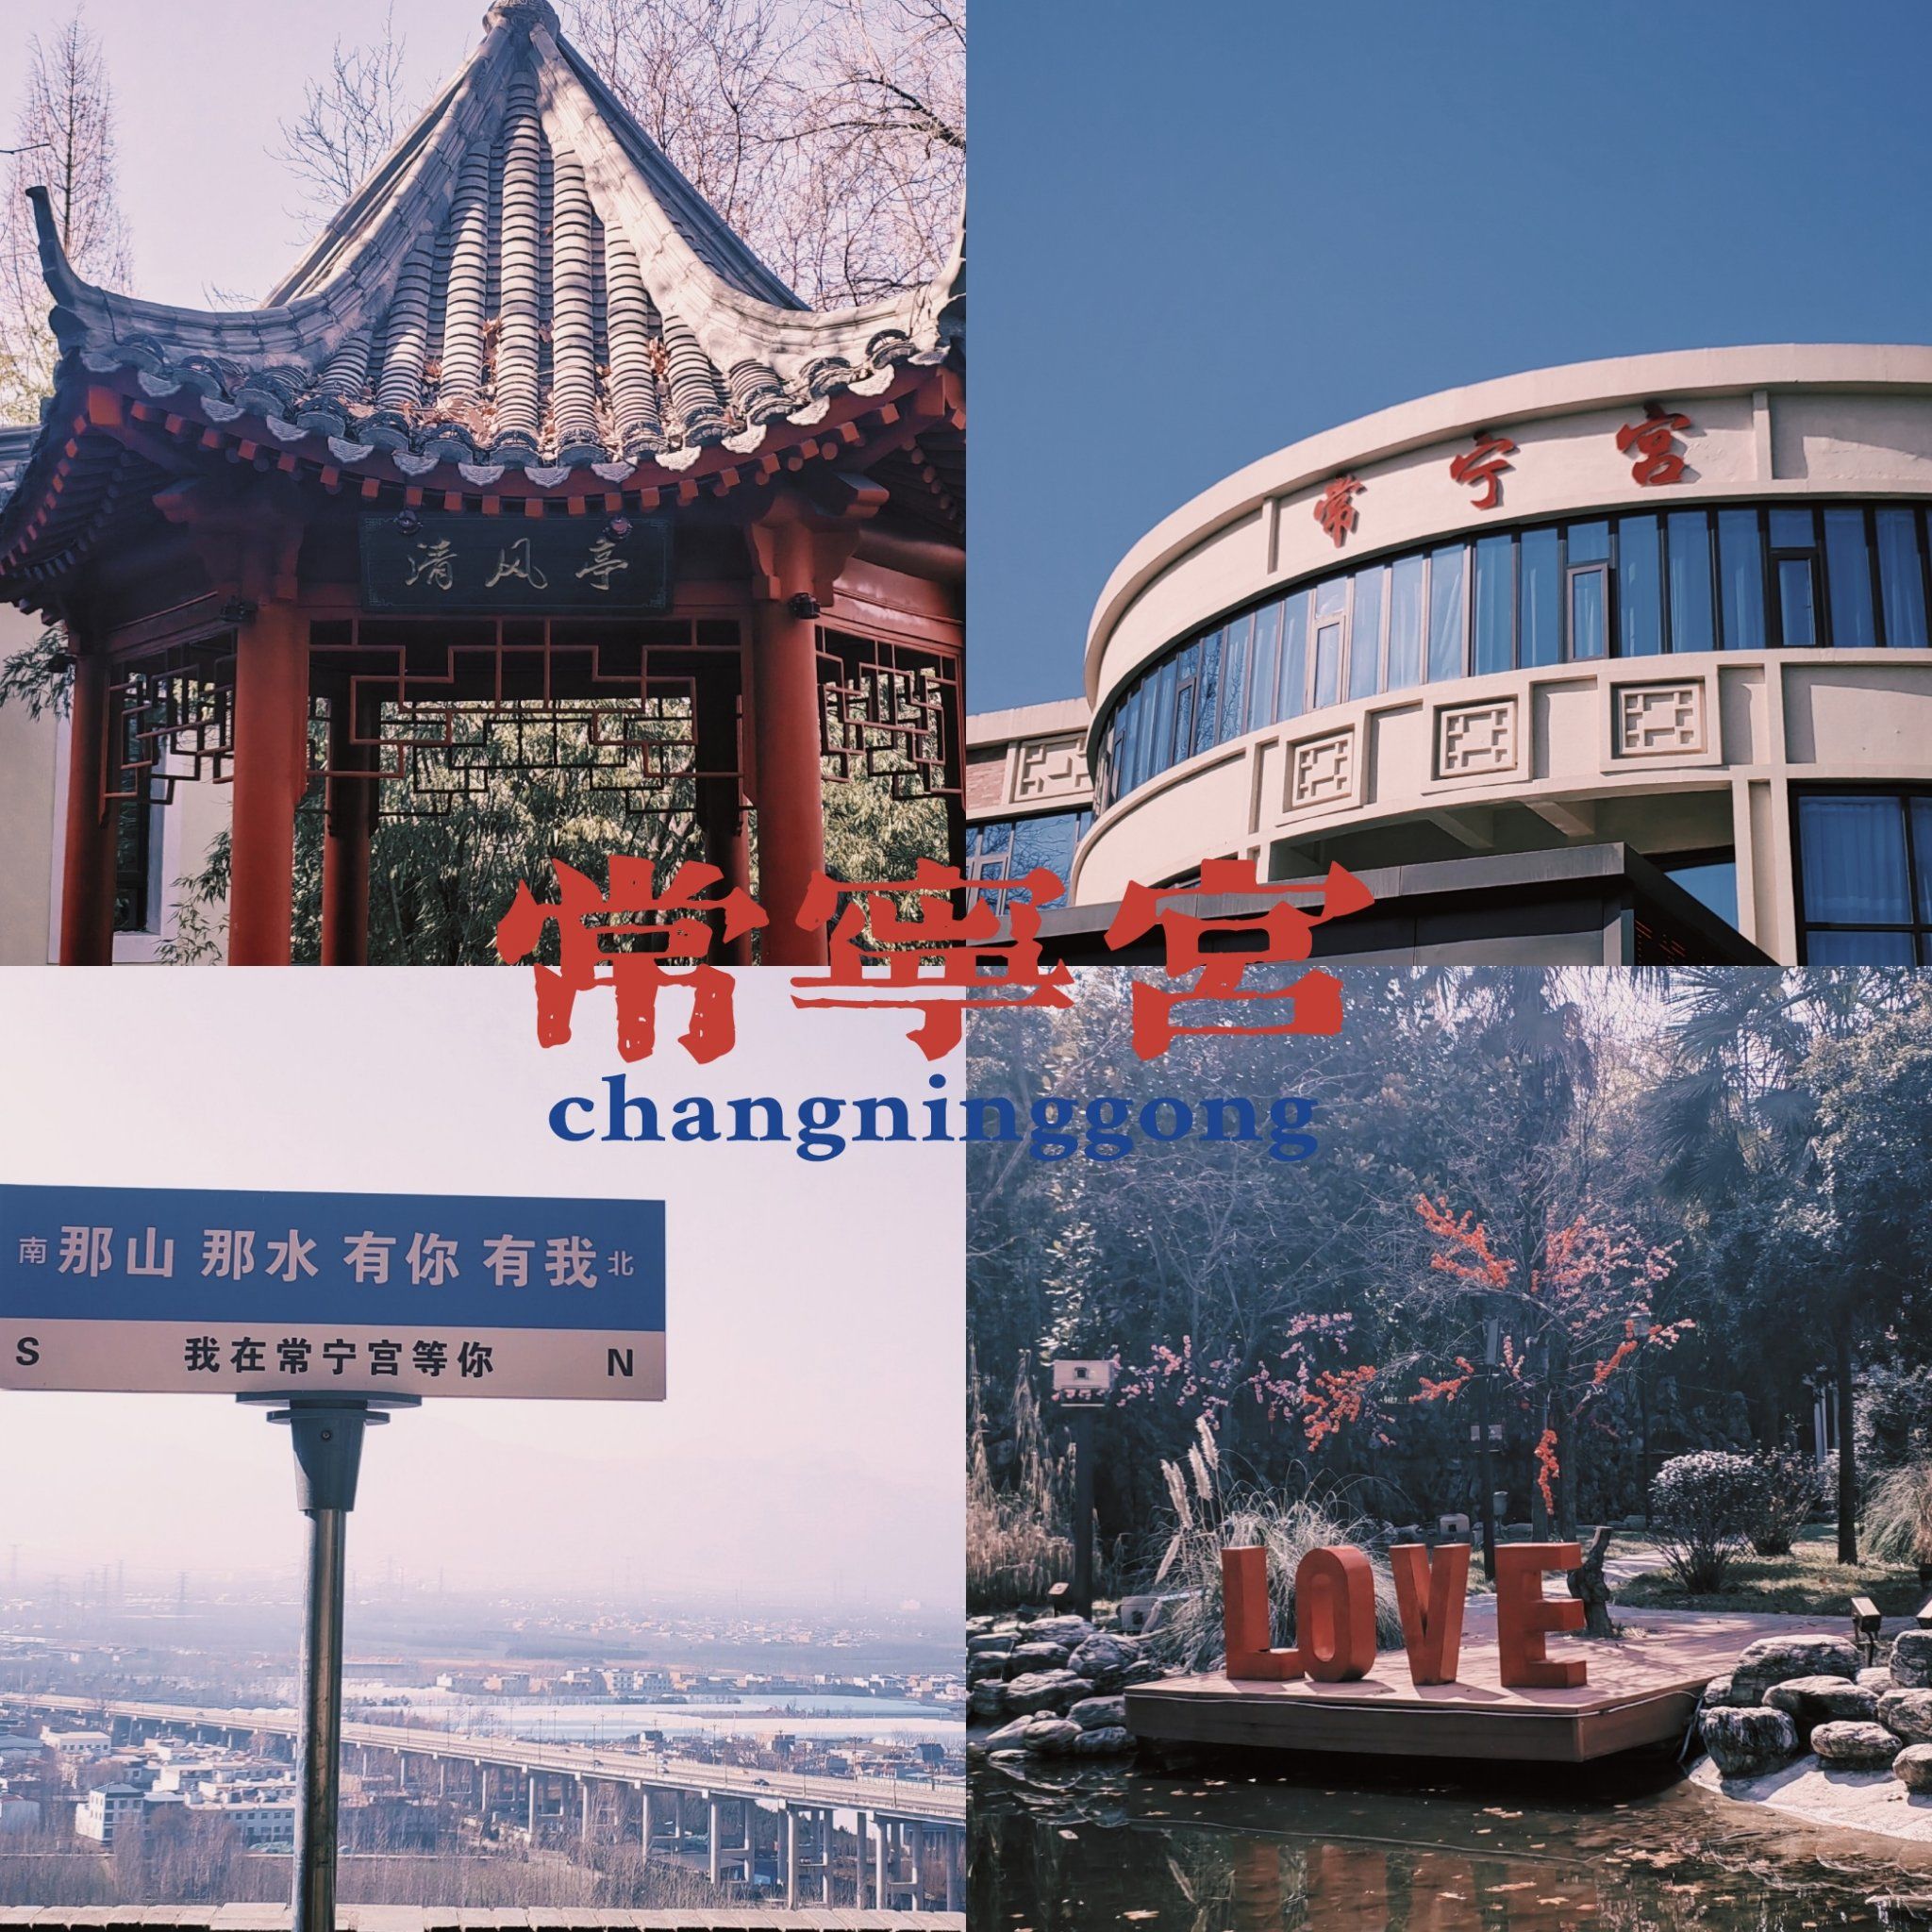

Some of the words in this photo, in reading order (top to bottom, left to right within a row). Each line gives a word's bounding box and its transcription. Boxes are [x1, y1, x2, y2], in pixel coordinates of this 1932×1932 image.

[405, 537, 628, 591] 清风亭
[19, 1236, 47, 1264] 南
[58, 1225, 175, 1278] 那山
[201, 1229, 319, 1282] 那水
[343, 1230, 459, 1286] 有你
[483, 1234, 597, 1289] 有我
[607, 1251, 634, 1276] 北
[15, 1337, 40, 1366] S
[184, 1336, 493, 1378] 我在常宁宫等你
[608, 1349, 633, 1376] N
[1221, 1542, 1588, 1688] LOVE
